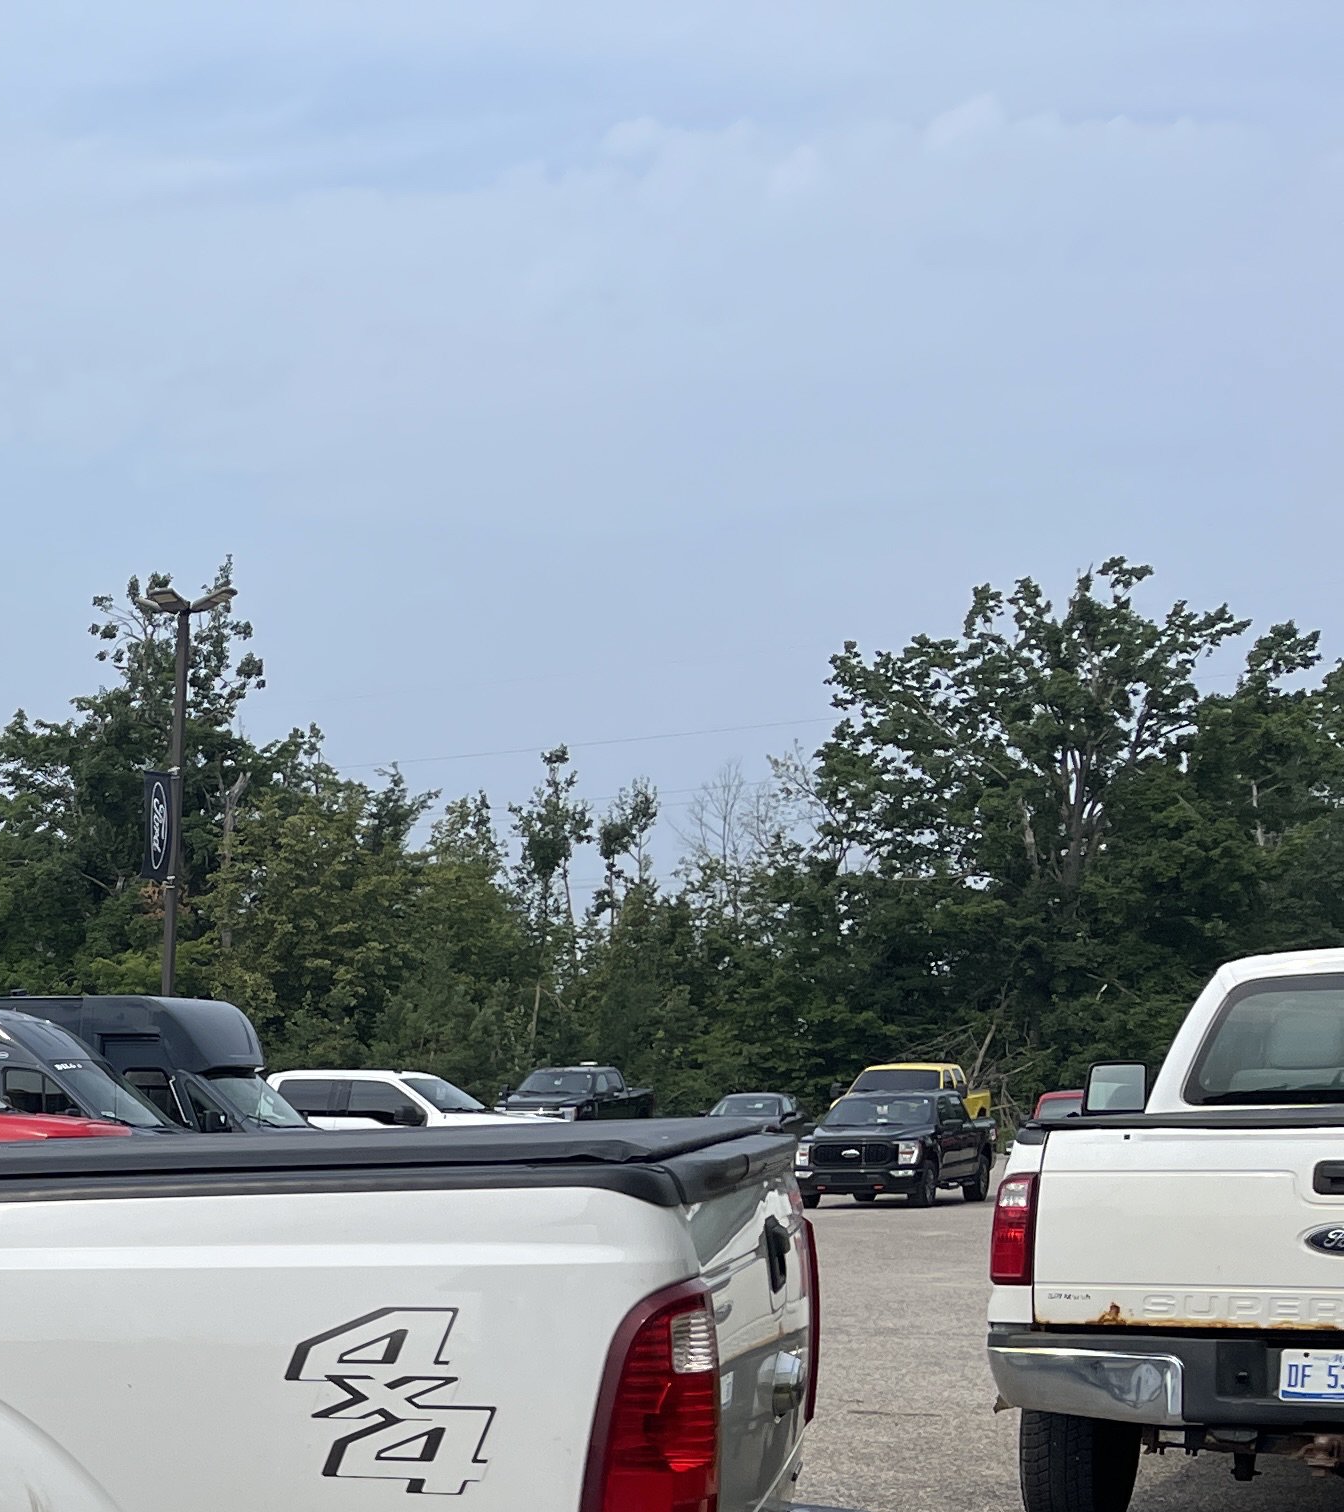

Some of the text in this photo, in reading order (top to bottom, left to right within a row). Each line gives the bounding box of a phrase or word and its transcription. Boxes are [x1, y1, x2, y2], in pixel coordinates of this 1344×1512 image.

[153, 797, 166, 854] Ford
[1141, 1293, 1344, 1322] SUPER
[1287, 1363, 1314, 1389] DF
